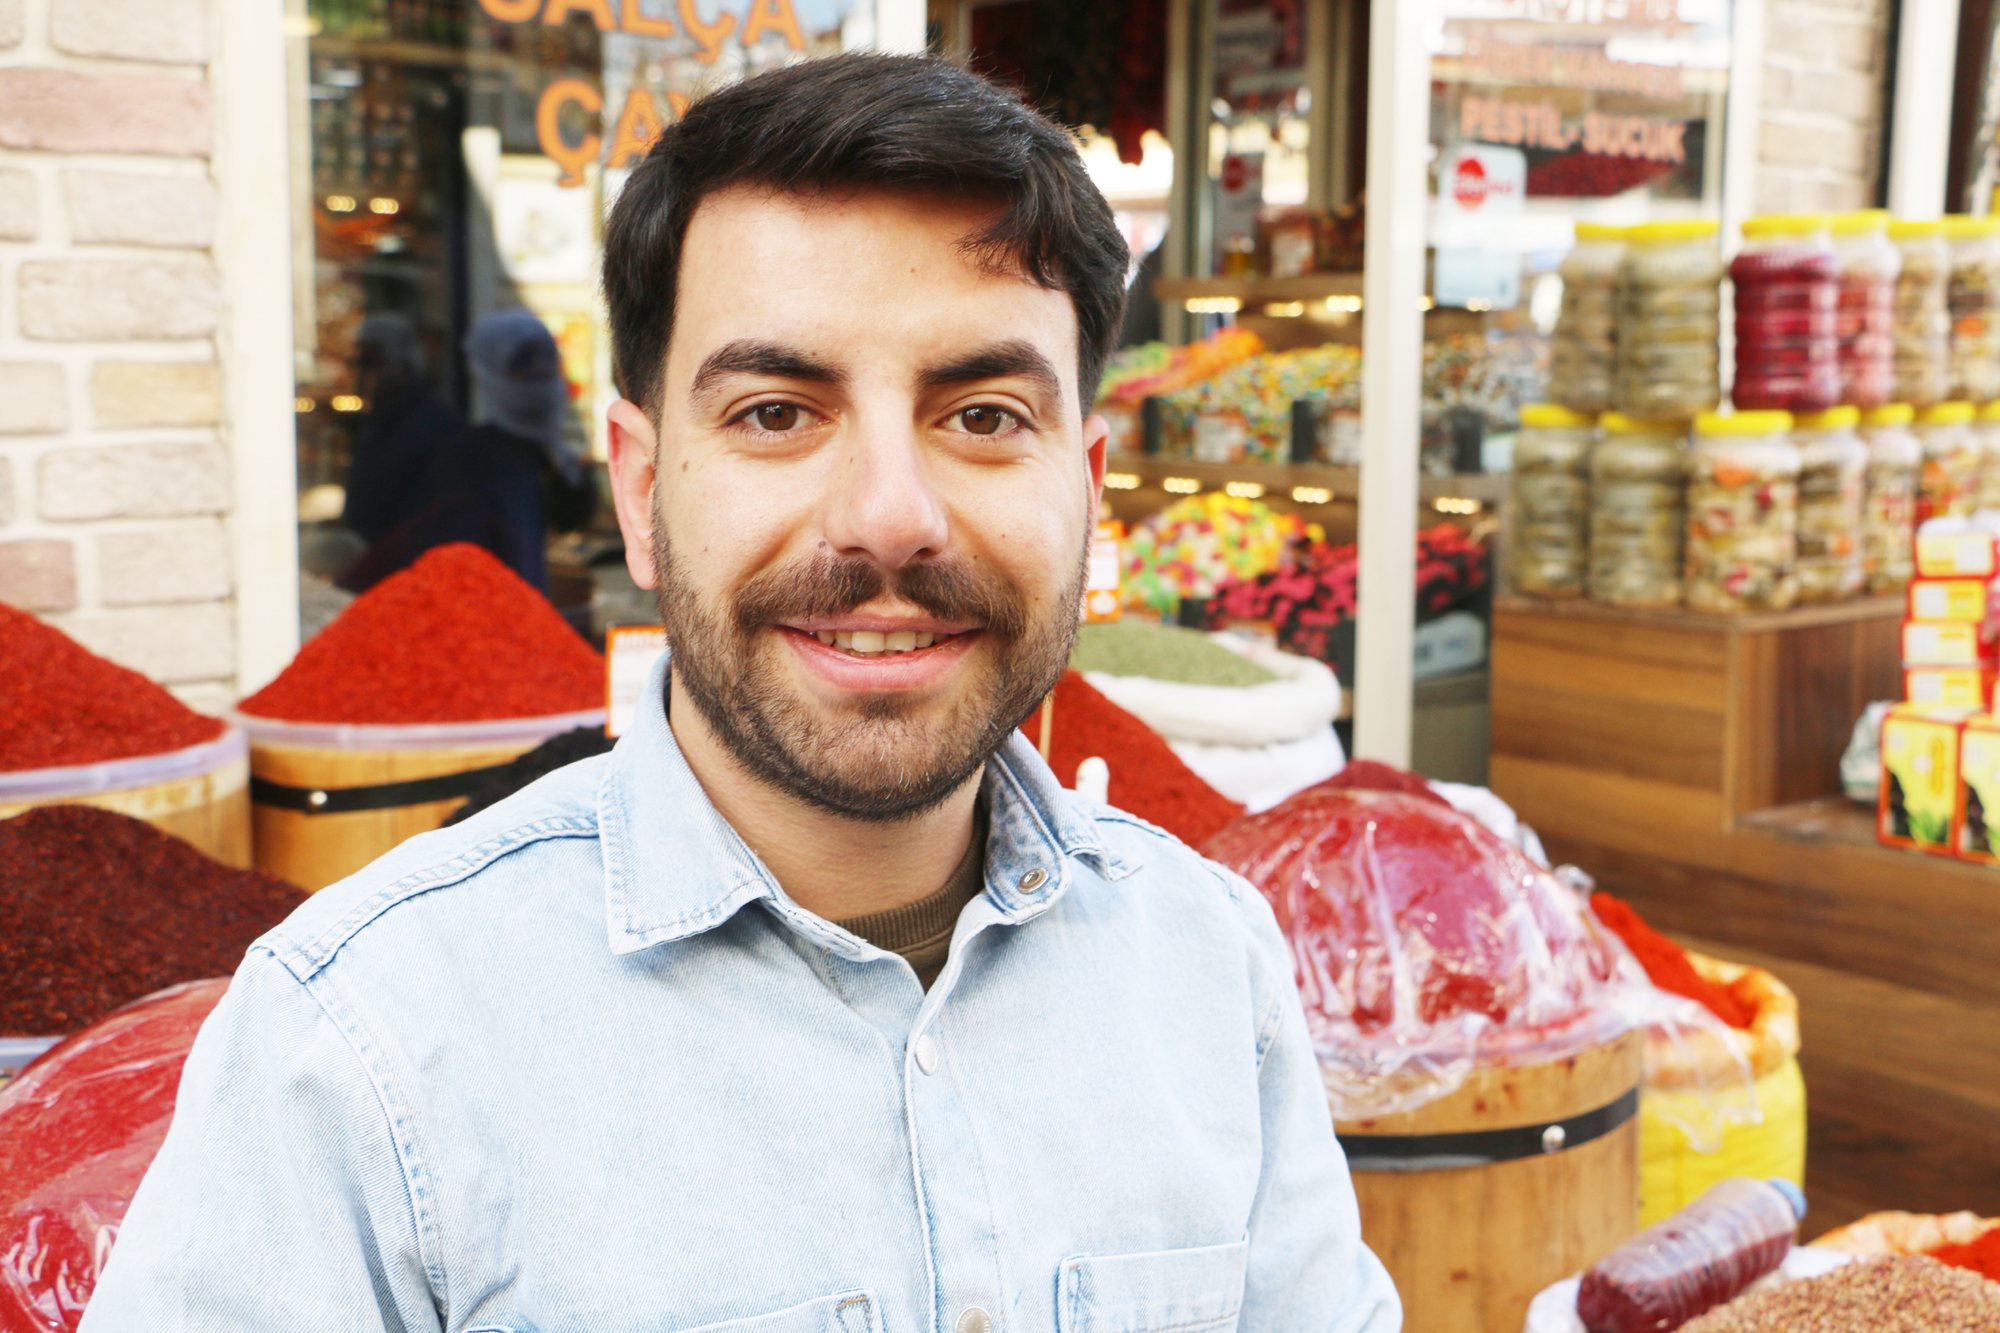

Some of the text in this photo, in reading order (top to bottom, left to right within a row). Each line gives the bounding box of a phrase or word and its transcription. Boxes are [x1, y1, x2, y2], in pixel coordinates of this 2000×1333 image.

[480, 0, 805, 62] LÇA
[536, 79, 691, 187] ÇA
[1461, 96, 1685, 162] PESTİL SUCUK
